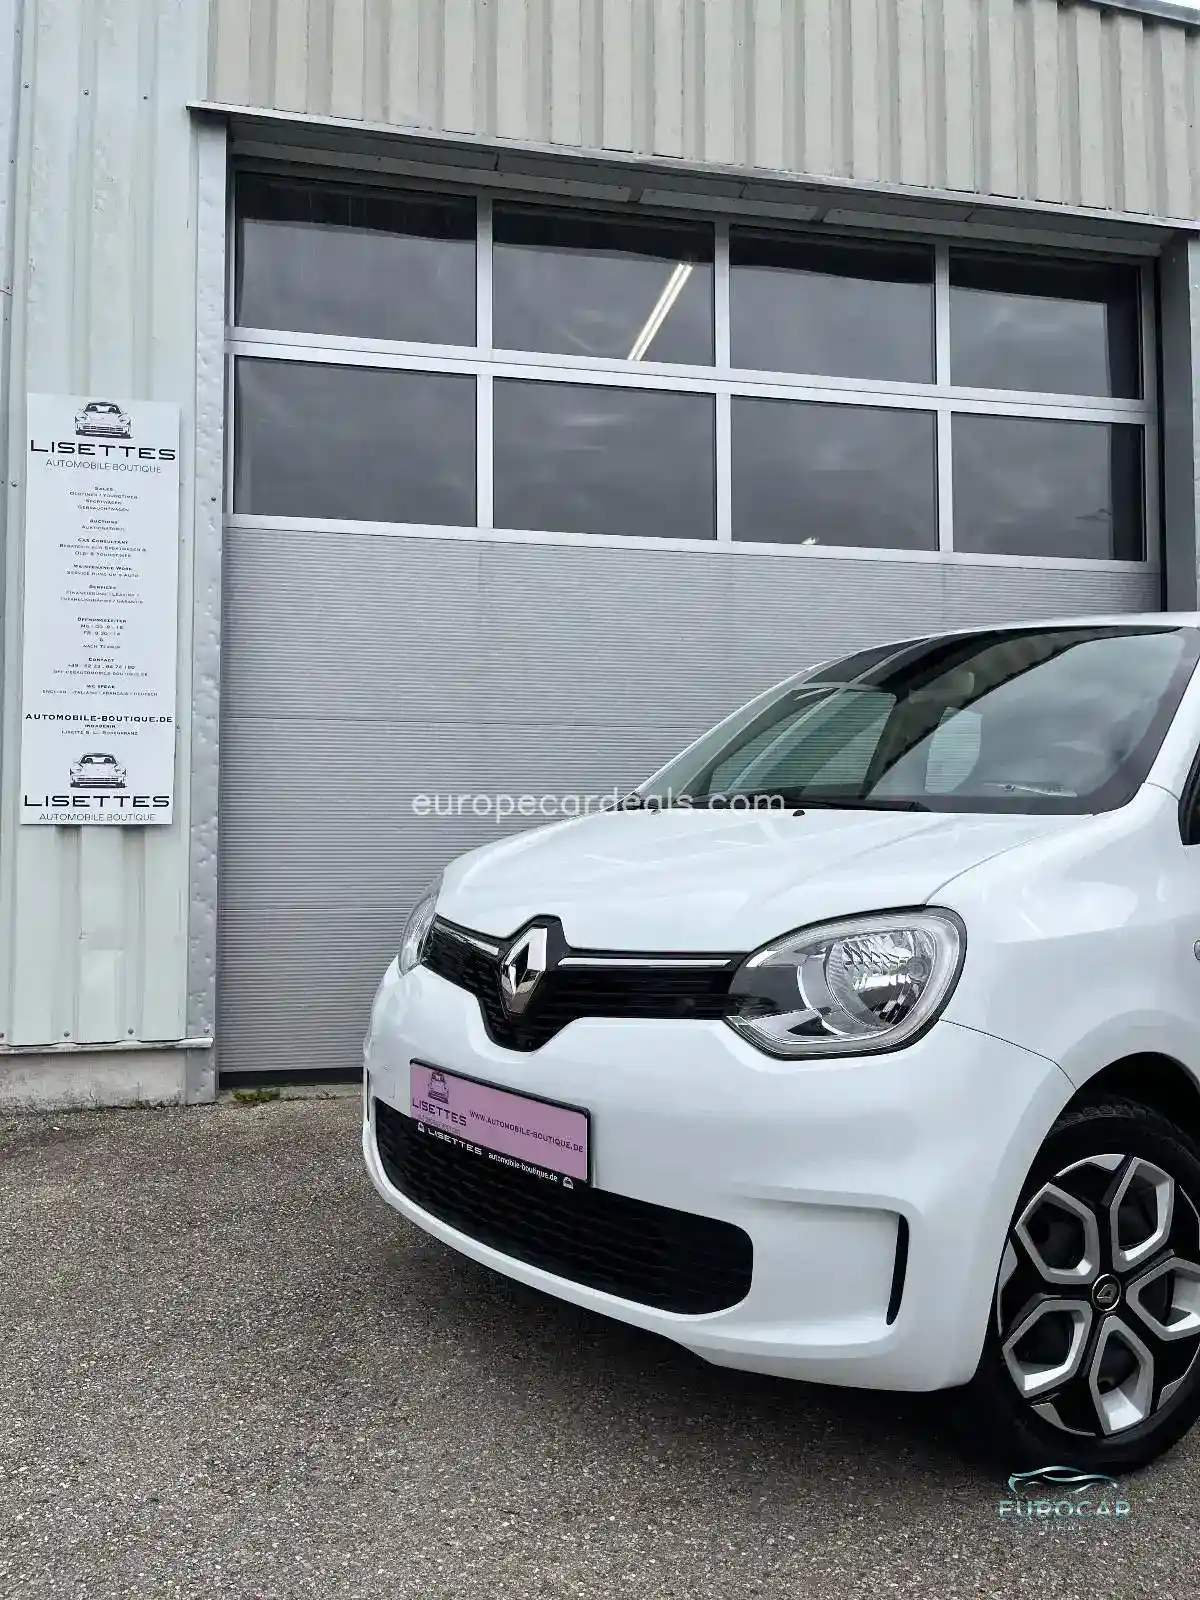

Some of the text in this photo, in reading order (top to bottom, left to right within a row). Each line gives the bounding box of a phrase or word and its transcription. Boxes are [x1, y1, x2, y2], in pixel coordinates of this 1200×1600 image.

[30, 440, 176, 461] LISETTES
[46, 458, 162, 474] AUTOMOBILE BOUTIQUE
[25, 713, 174, 723] AUTOMOBILE-BOUTIQUE.DE
[24, 794, 170, 808] LISETTES
[39, 813, 157, 822] AUTOMOBILE BOUTIQUE
[412, 1097, 468, 1127] LISETTES
[469, 1109, 584, 1153] WWW.AUTOMOBILE-BOUTIQUE.DE
[427, 1128, 483, 1156] LISETTES
[488, 1151, 558, 1183] automobile-boutique.de
